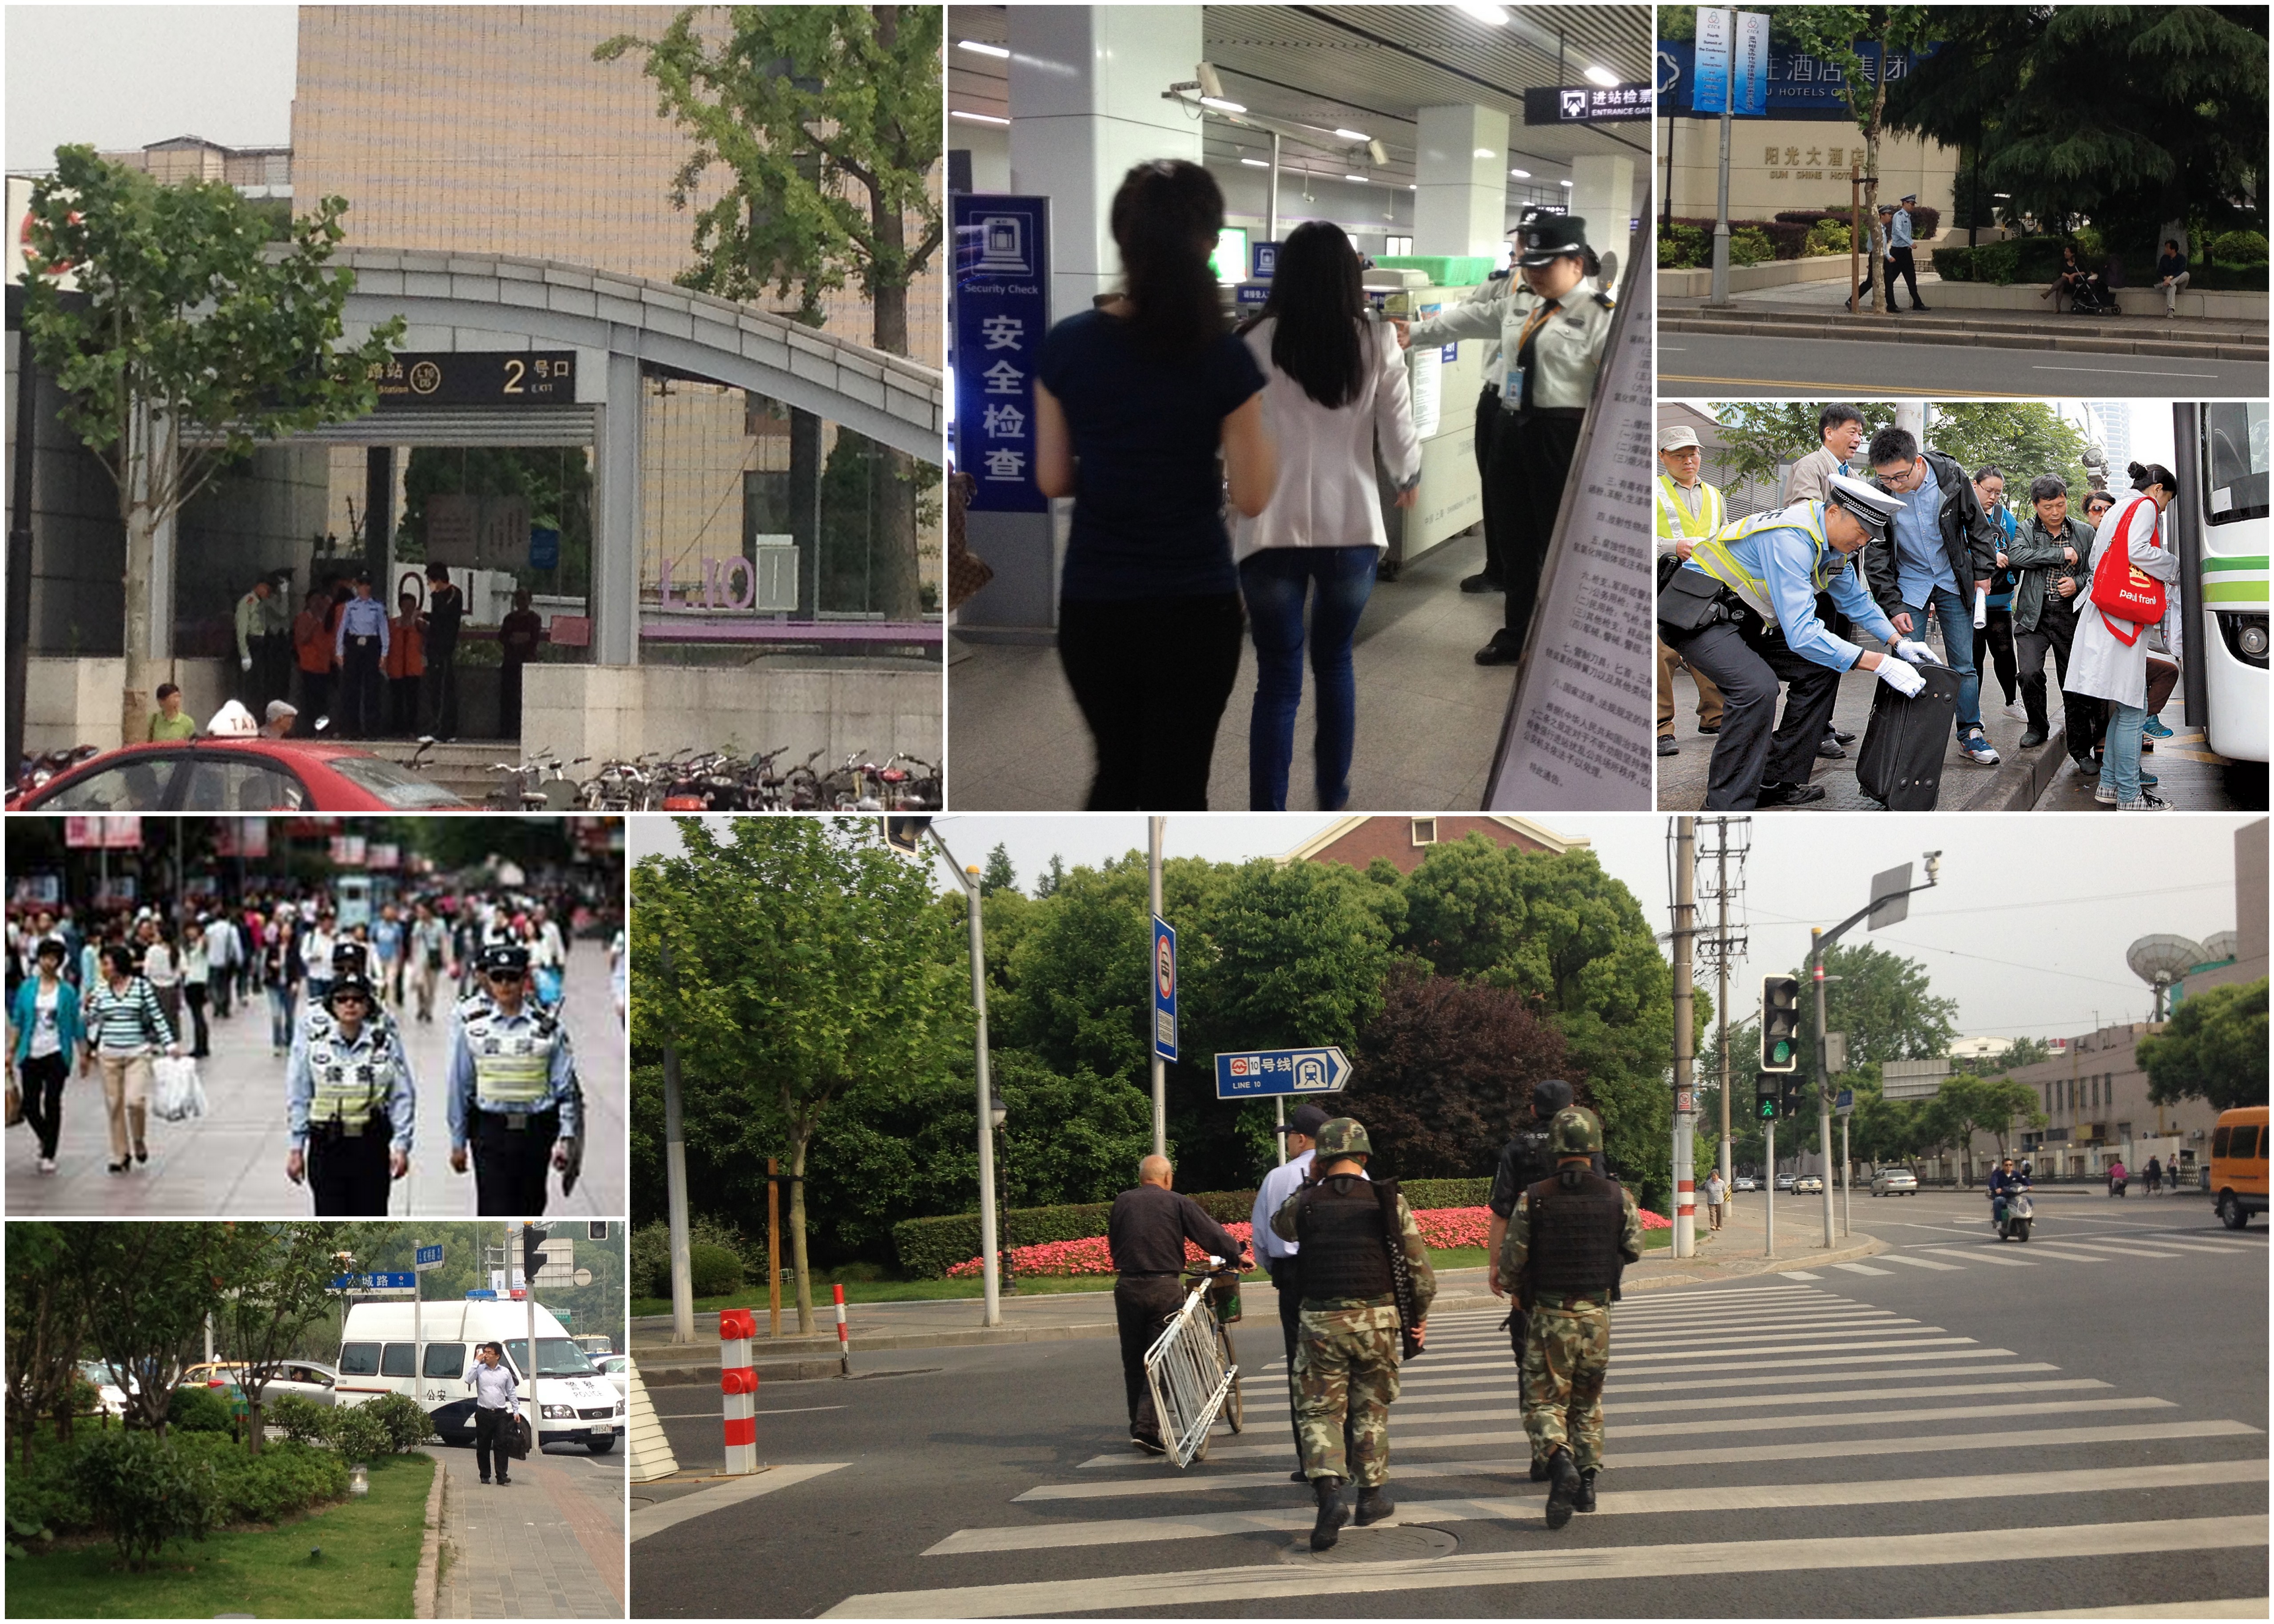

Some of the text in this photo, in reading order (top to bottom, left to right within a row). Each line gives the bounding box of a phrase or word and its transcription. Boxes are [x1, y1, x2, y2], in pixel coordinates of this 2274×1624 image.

[1591, 107, 1634, 116] ENTRANCE
[1765, 146, 1865, 166] 阳光大酒店
[1796, 171, 1822, 180] SHINE
[1830, 171, 1853, 180] HOTE
[965, 283, 1038, 295] Security Check
[1244, 290, 1270, 299] 请接受人
[504, 360, 569, 393] 2 号口
[982, 314, 1026, 482] 安全检查
[2119, 589, 2138, 602] paul
[1250, 1057, 1292, 1072] 10 号线
[426, 1389, 446, 1402] 公安
